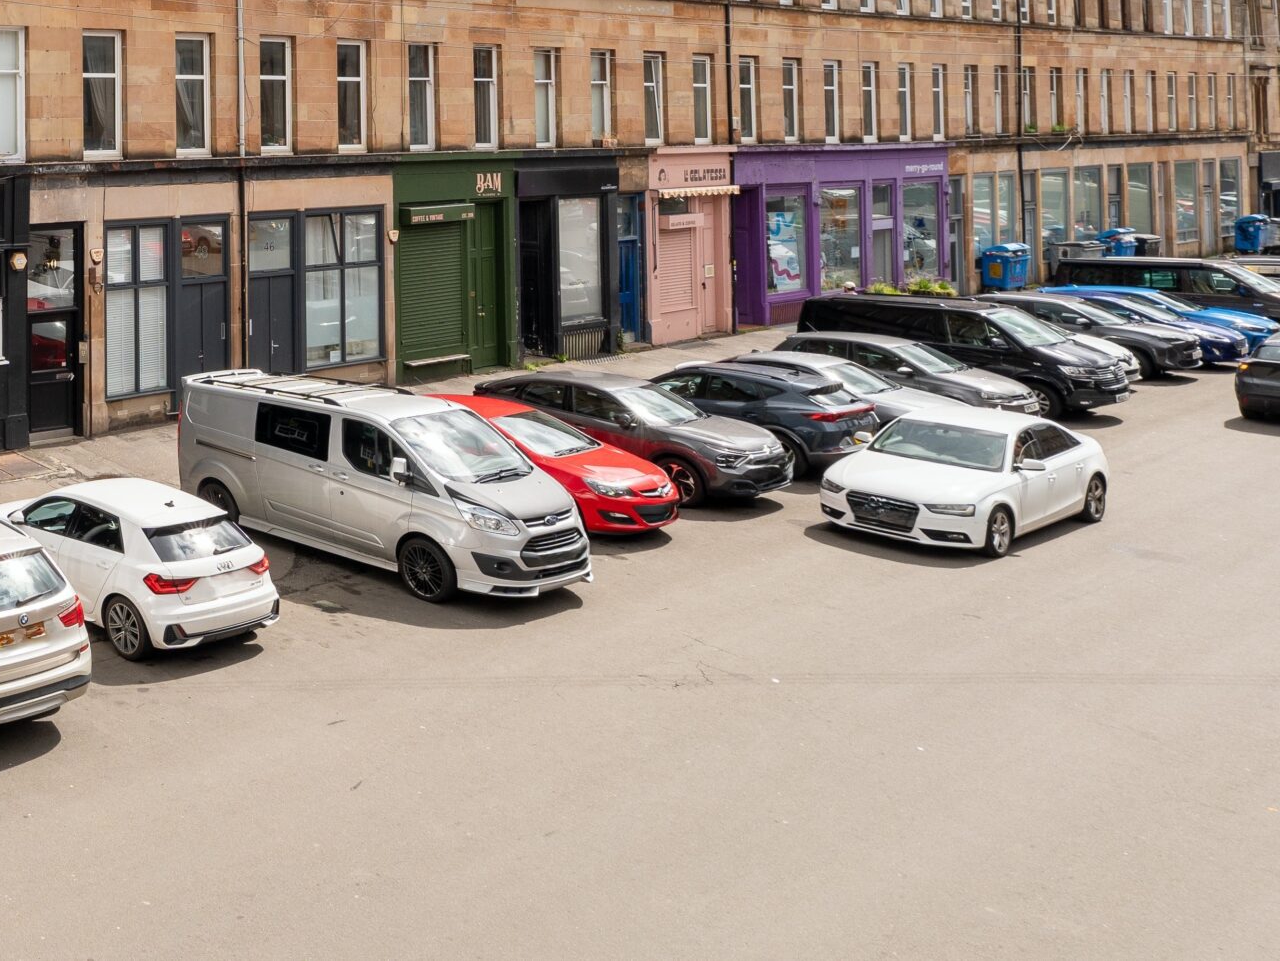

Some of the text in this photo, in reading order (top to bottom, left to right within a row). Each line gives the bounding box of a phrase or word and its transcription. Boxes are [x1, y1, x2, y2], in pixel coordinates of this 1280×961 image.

[905, 161, 944, 174] merry-go-round
[689, 168, 727, 182] GELATESSA
[475, 172, 502, 193] BAM
[263, 242, 275, 252] 46
